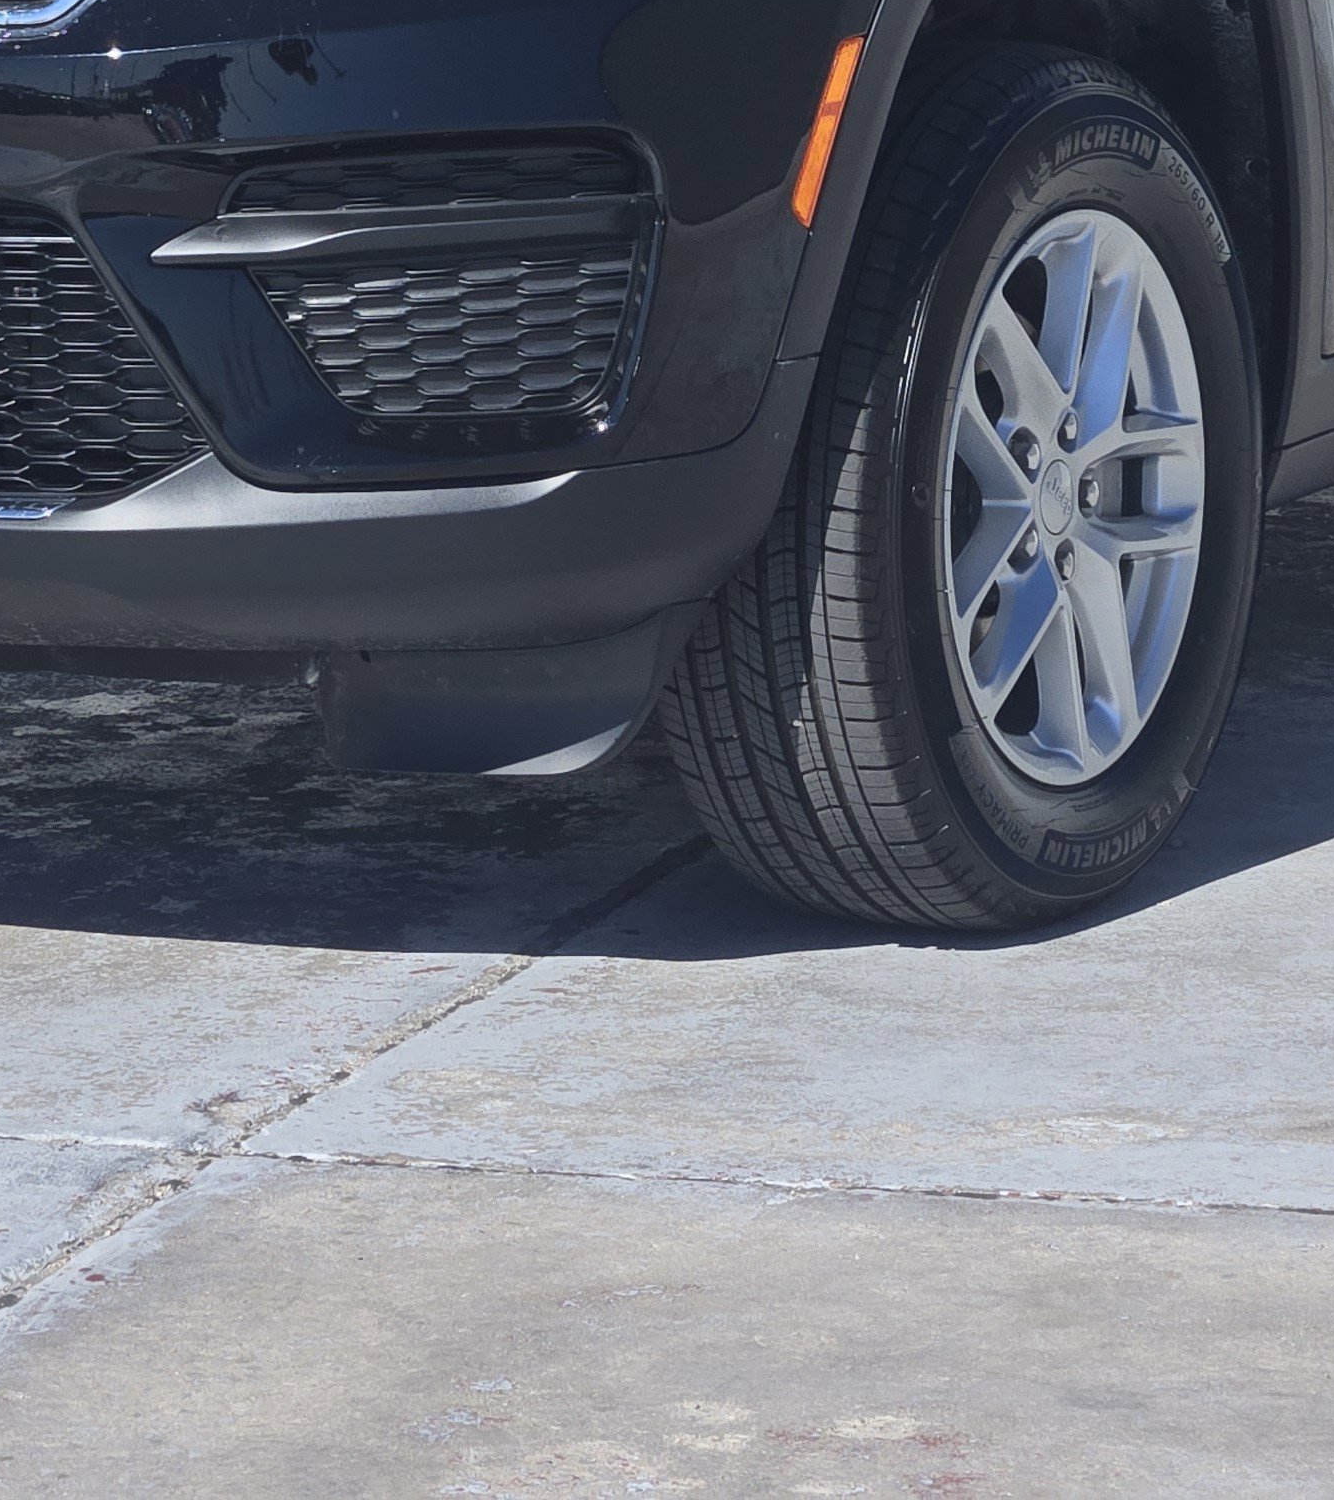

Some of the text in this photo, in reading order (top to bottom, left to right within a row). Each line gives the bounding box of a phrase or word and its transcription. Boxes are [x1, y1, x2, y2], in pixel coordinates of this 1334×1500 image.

[1054, 124, 1156, 166] MICHELIN
[1168, 156, 1206, 211] 265/60
[974, 782, 1030, 849] PRIMACY
[1043, 818, 1147, 868] MICHELIN
